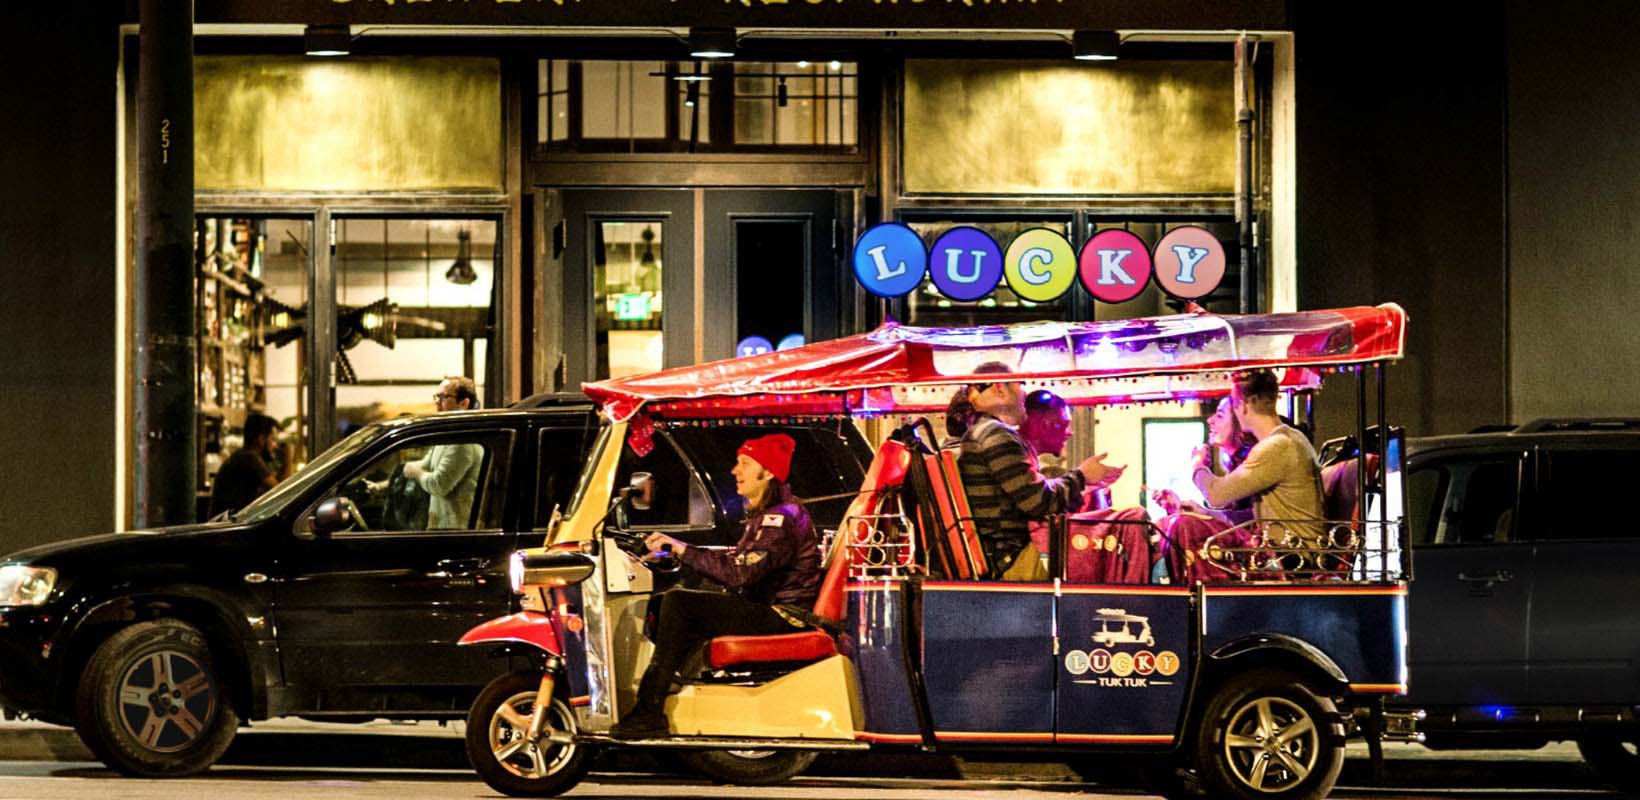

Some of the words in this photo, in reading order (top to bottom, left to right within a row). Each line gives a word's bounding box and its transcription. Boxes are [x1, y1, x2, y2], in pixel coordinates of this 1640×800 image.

[161, 119, 170, 164] 251
[866, 243, 1209, 286] LUCKY
[1071, 654, 1174, 672] LUCKY
[1098, 677, 1122, 687] TUK
[1123, 677, 1147, 688] TUK
